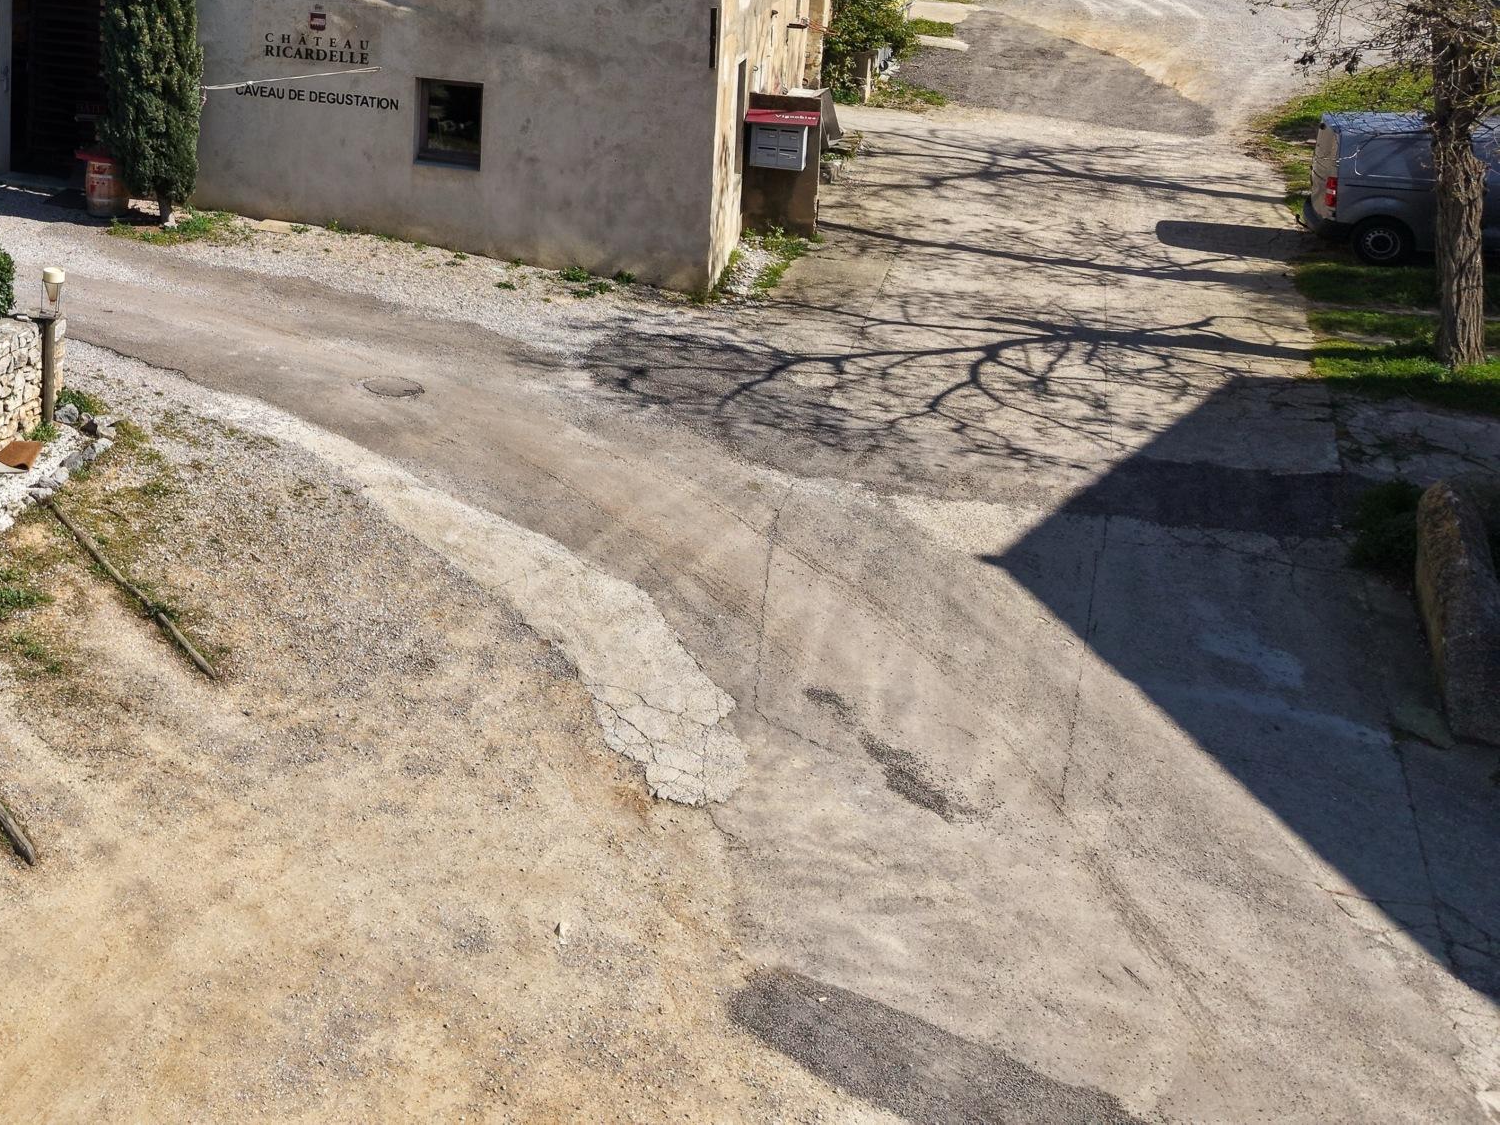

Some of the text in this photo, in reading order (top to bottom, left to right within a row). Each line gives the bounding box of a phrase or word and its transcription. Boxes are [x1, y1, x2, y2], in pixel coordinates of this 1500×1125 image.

[265, 33, 369, 50] CHÂTEAU
[265, 45, 369, 64] RICARDELLE
[235, 84, 399, 110] CAVEAU DE DEGUSTATION
